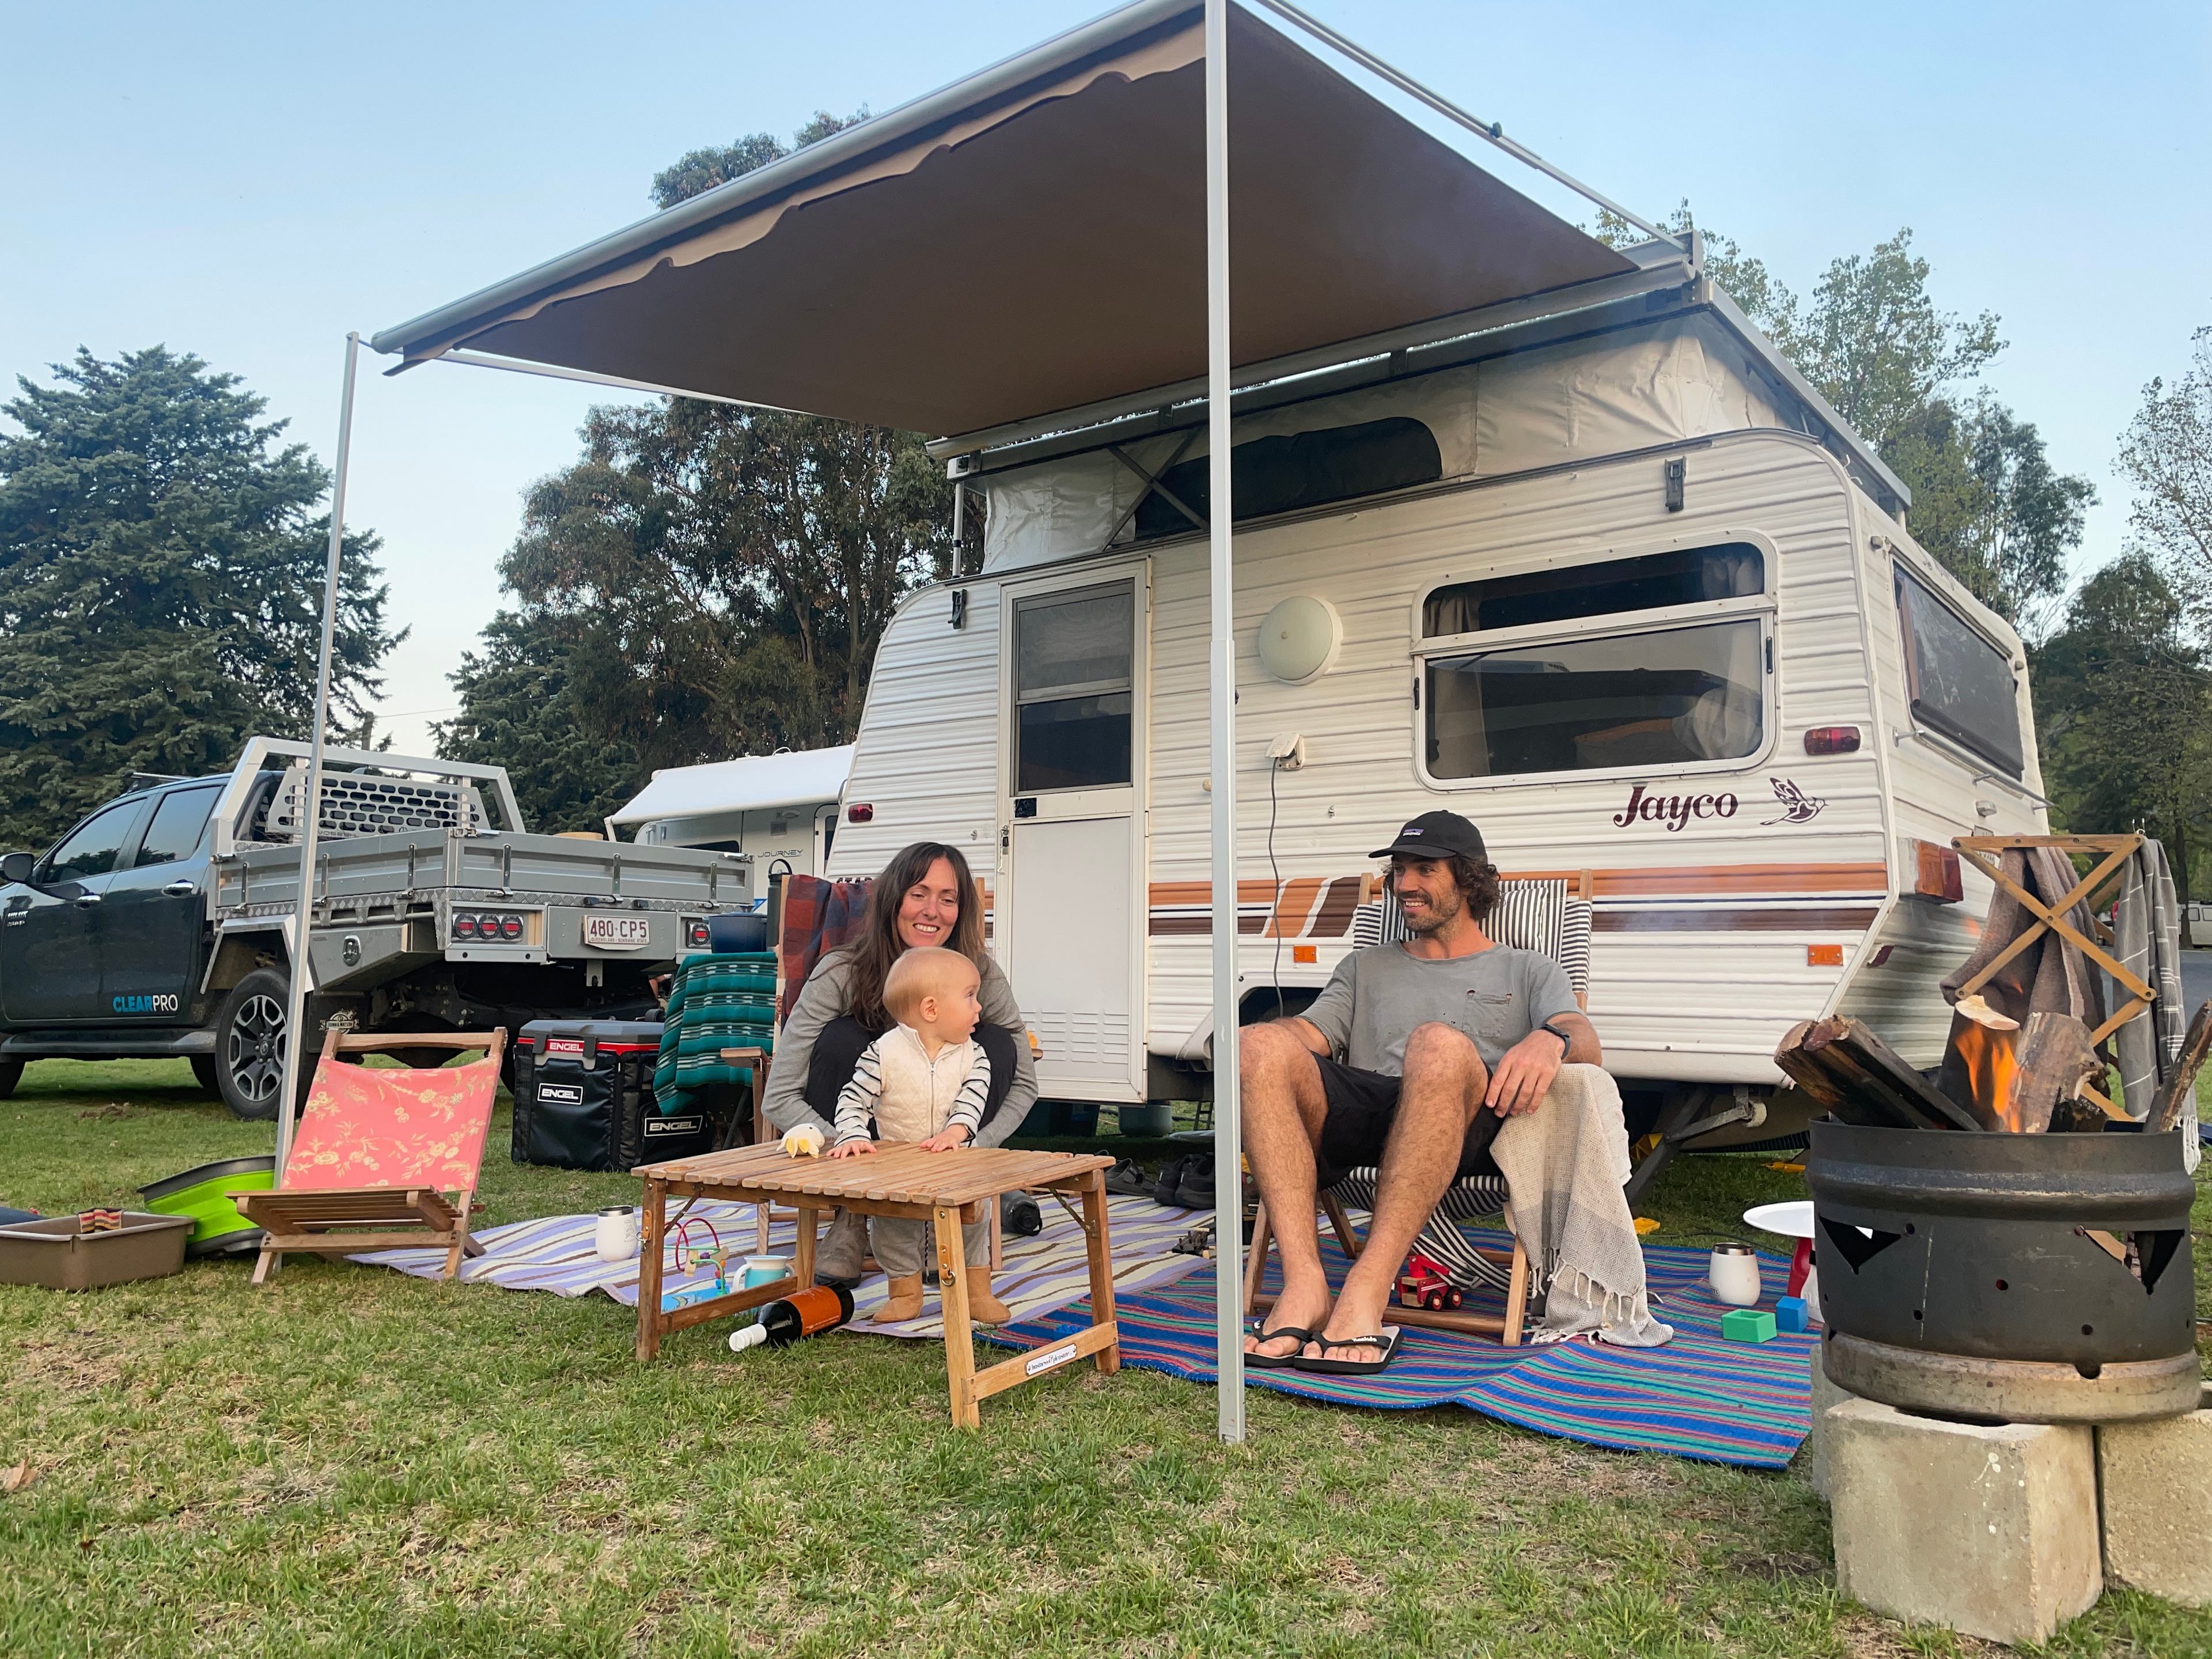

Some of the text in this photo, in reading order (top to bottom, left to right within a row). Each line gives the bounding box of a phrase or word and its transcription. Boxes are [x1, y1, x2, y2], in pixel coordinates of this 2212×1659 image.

[1613, 782, 1738, 832] Jayco
[757, 849, 804, 858] JOURNEY
[113, 994, 179, 1013] CLEARPRO
[550, 1042, 584, 1052] ENGEL
[541, 1088, 579, 1100] ENGEL
[649, 1121, 697, 1131] ENGEL
